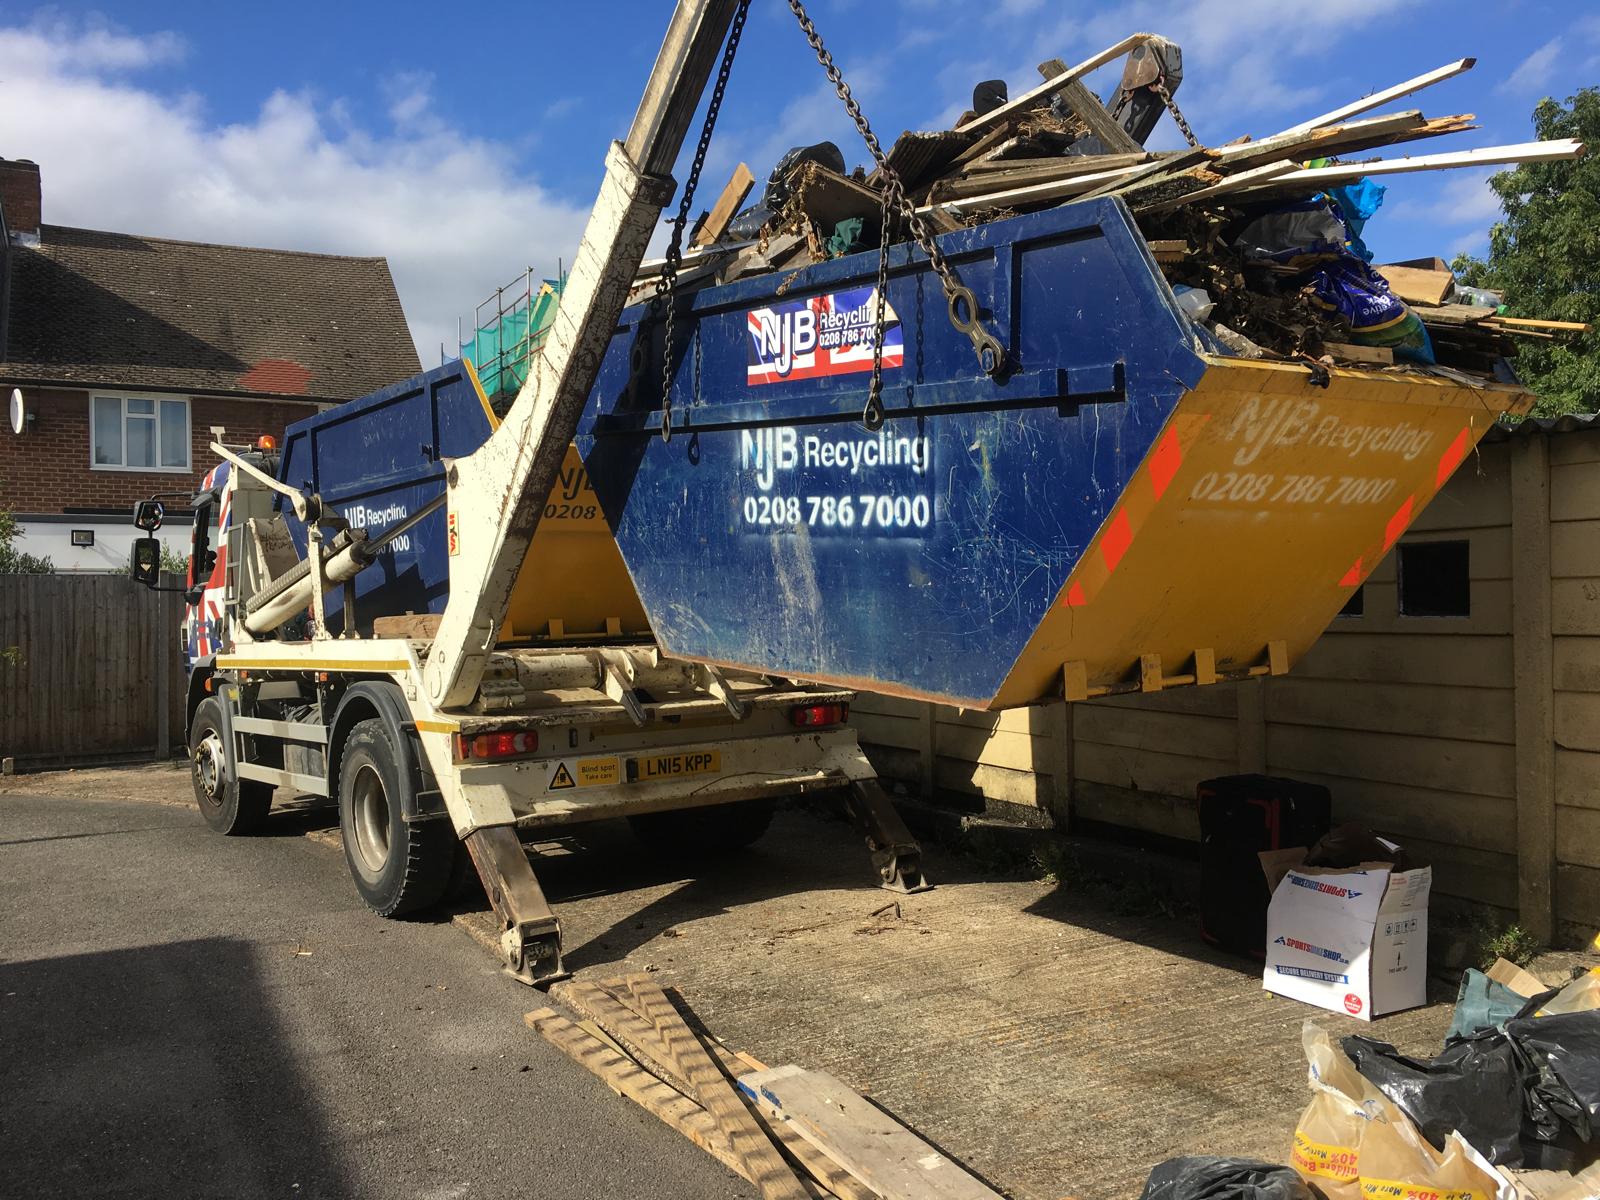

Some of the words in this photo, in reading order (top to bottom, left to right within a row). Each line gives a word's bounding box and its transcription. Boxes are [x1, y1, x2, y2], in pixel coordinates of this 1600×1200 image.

[760, 309, 817, 375] NJB
[820, 304, 872, 329] Recyclin
[820, 332, 840, 347] 0208
[842, 329, 859, 345] 786
[860, 326, 878, 341] 700
[1226, 397, 1319, 466] NJB
[1311, 415, 1433, 461] Recycling
[742, 428, 798, 490] NJB
[804, 431, 929, 475] Recycling
[1191, 471, 1274, 502] 0208
[1270, 475, 1331, 503] 786
[1325, 476, 1397, 503] 7000
[543, 504, 597, 520] 0208
[743, 496, 801, 525] 0208
[807, 495, 856, 527] 786
[859, 495, 930, 527] 7000
[581, 765, 598, 773] Blind
[600, 764, 616, 773] spot
[647, 757, 681, 776] LN15
[685, 754, 712, 772] KPP
[1320, 1162, 1358, 1177] uilders
[1331, 1153, 1358, 1165] 40%
[1381, 1185, 1402, 1196] More
